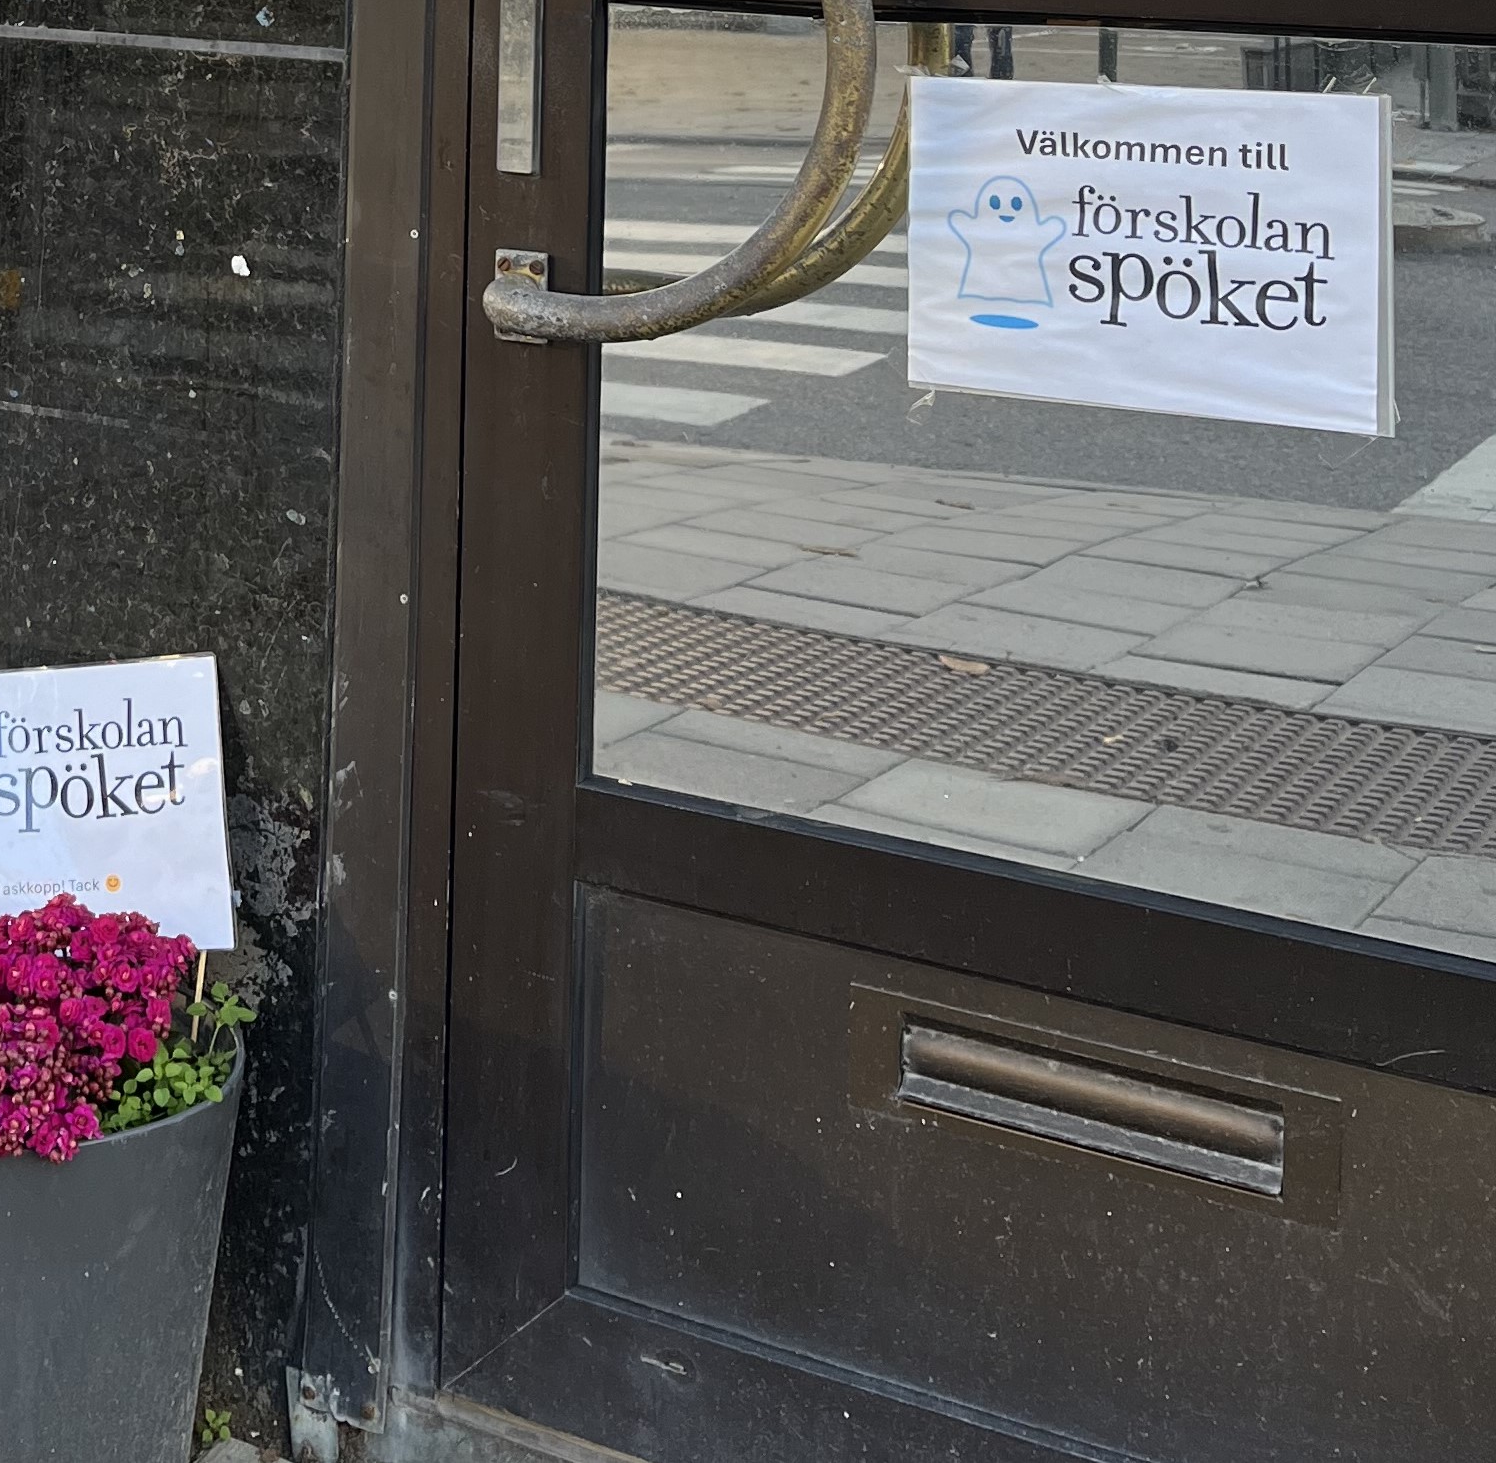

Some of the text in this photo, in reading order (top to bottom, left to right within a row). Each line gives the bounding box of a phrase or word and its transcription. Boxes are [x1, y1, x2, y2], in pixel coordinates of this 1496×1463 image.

[1015, 128, 1290, 171] Välkommen till
[1071, 184, 1336, 261] förskolan
[1067, 249, 1329, 331] spöket
[3, 880, 65, 896] askkopp!
[68, 878, 101, 893] Tack
